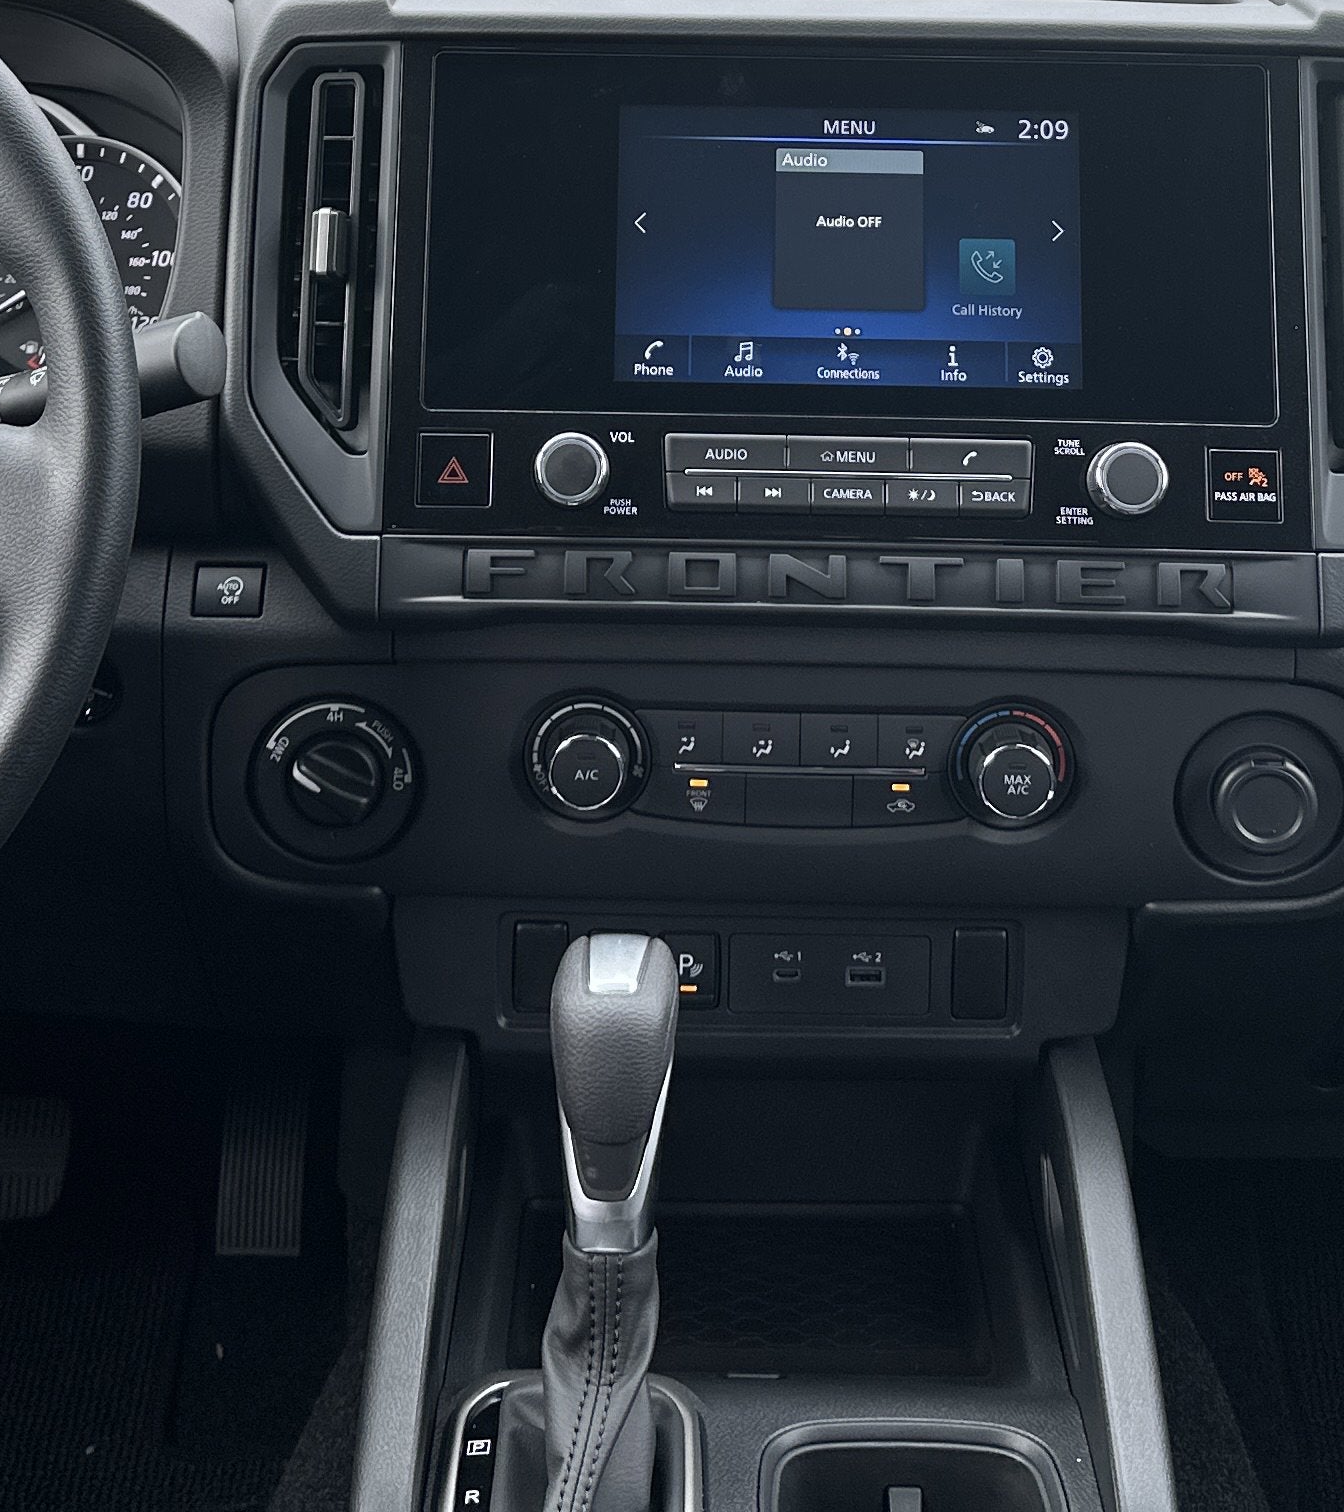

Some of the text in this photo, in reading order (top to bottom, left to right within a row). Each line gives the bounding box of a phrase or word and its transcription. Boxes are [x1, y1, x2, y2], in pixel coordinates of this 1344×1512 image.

[823, 119, 876, 135] MENU
[1017, 119, 1069, 140] 2:09
[781, 152, 828, 168] Audio
[126, 191, 154, 209] 80
[101, 210, 119, 221] 120
[815, 215, 882, 229] Audio OFF
[120, 229, 138, 240] 140
[128, 256, 145, 267] 160
[124, 285, 142, 296] 180
[951, 302, 1023, 320] Call History
[633, 362, 674, 377] Phone
[724, 363, 763, 379] Audio
[816, 366, 881, 381] Connections
[940, 367, 968, 382] Info
[1017, 370, 1070, 387] Settings
[609, 431, 635, 444] VOL
[1057, 438, 1081, 448] TUNE
[705, 447, 748, 462] AUDIO
[835, 449, 876, 464] MENU
[1054, 447, 1086, 456] SCROLL
[1224, 471, 1244, 482] OFF
[822, 487, 874, 501] CAMERA
[984, 490, 1017, 504] BACK
[1214, 491, 1277, 503] PASS AIR BAG
[609, 498, 633, 507] PUSH
[603, 506, 638, 516] POWER
[1059, 506, 1088, 516] ENTER
[1055, 516, 1094, 526] SETTING
[464, 548, 1233, 610] FRONTIER
[221, 595, 240, 605] OFF
[326, 710, 344, 723] 4H
[371, 720, 394, 743] PUSH
[269, 736, 290, 763] 2WD
[574, 769, 599, 781] A/C
[1003, 774, 1032, 786] MAX
[686, 789, 712, 798] FRONT
[1007, 785, 1030, 795] A/C
[874, 951, 883, 963] 2
[678, 953, 694, 976] P
[464, 1489, 480, 1505] R
